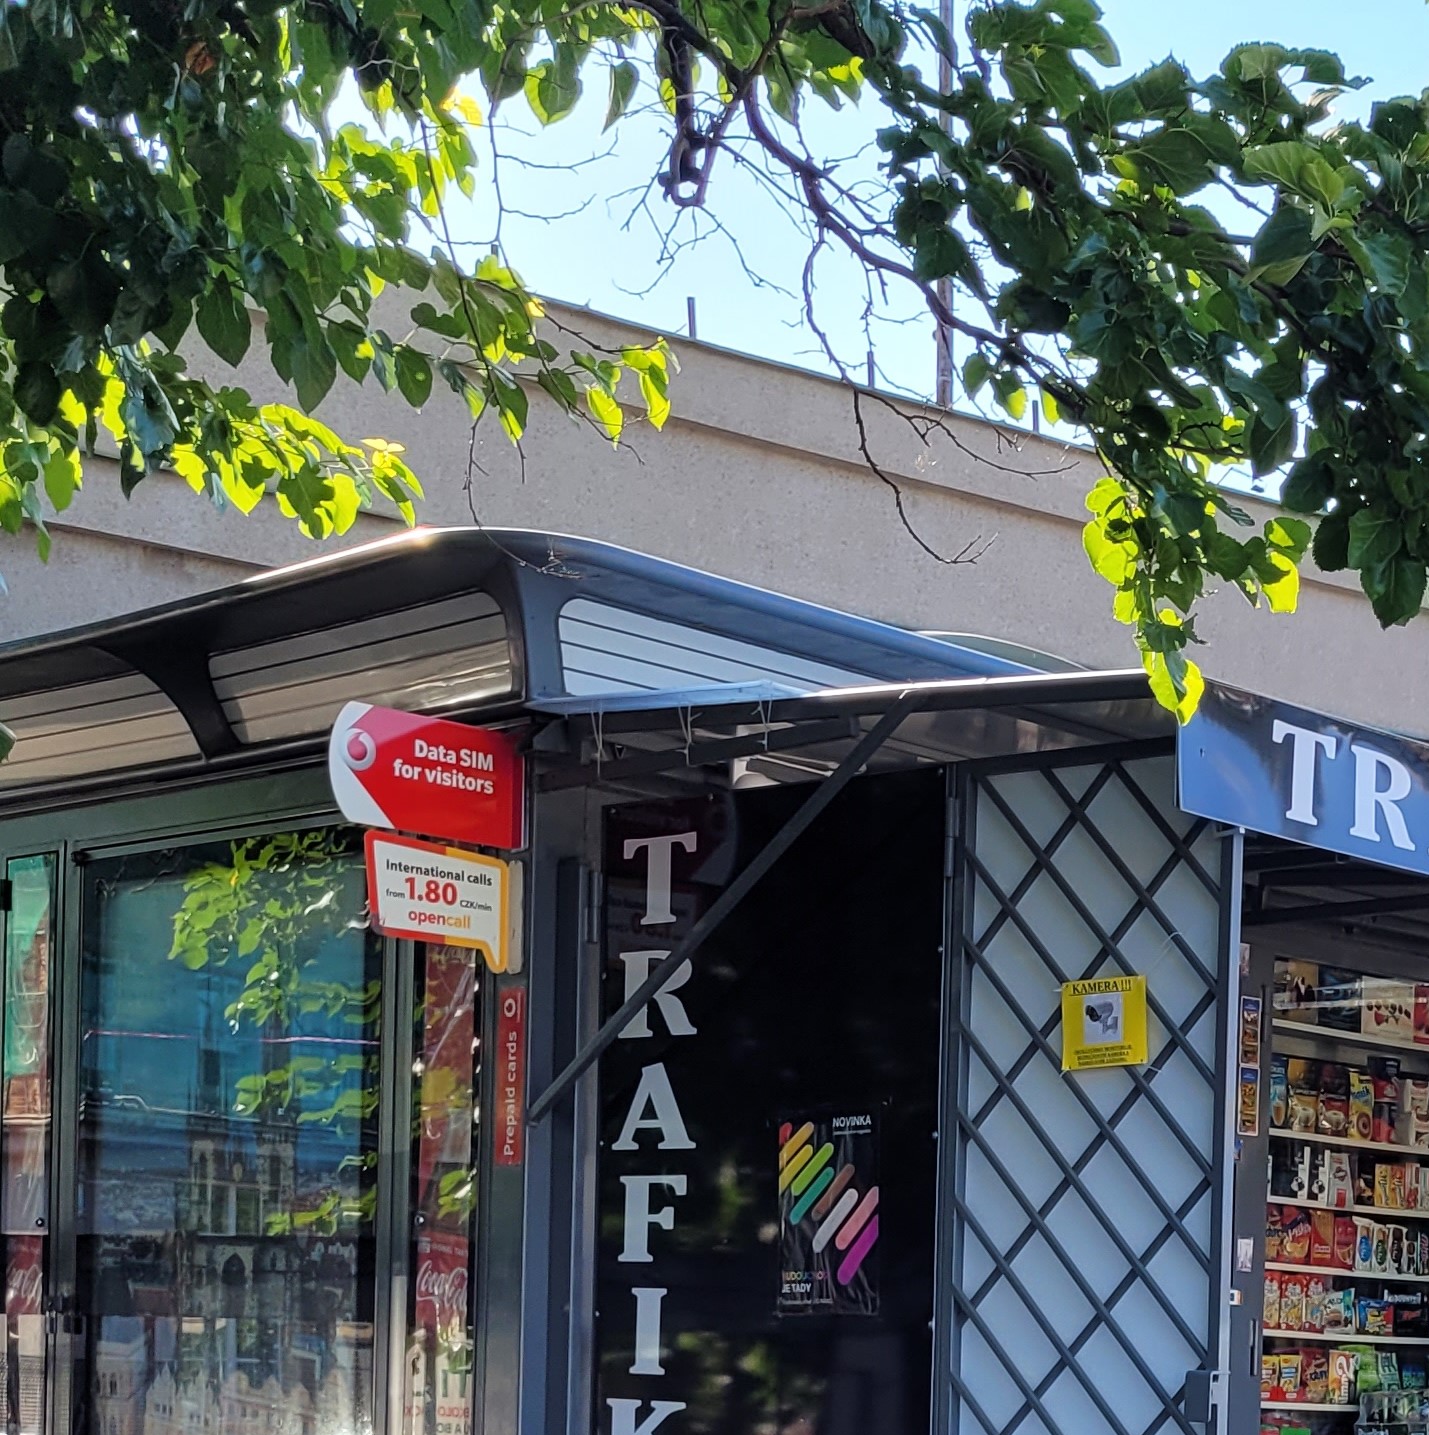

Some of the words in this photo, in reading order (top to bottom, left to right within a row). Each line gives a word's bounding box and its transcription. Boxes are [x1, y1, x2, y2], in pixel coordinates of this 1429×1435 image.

[414, 738, 457, 763] Data
[460, 746, 494, 772] SIM
[393, 758, 420, 779] for
[423, 765, 495, 795] visitors
[386, 858, 465, 883] International
[467, 867, 492, 887] calls
[386, 886, 406, 900] from
[405, 876, 458, 907] 1.80
[459, 898, 492, 912] CZK/min
[408, 908, 471, 930] opencall
[1071, 979, 1119, 995] KAMERA
[503, 1030, 517, 1091] cards
[502, 1096, 517, 1157] Prepaid
[832, 1115, 872, 1128] NOVINKA
[791, 1283, 812, 1294] TADY
